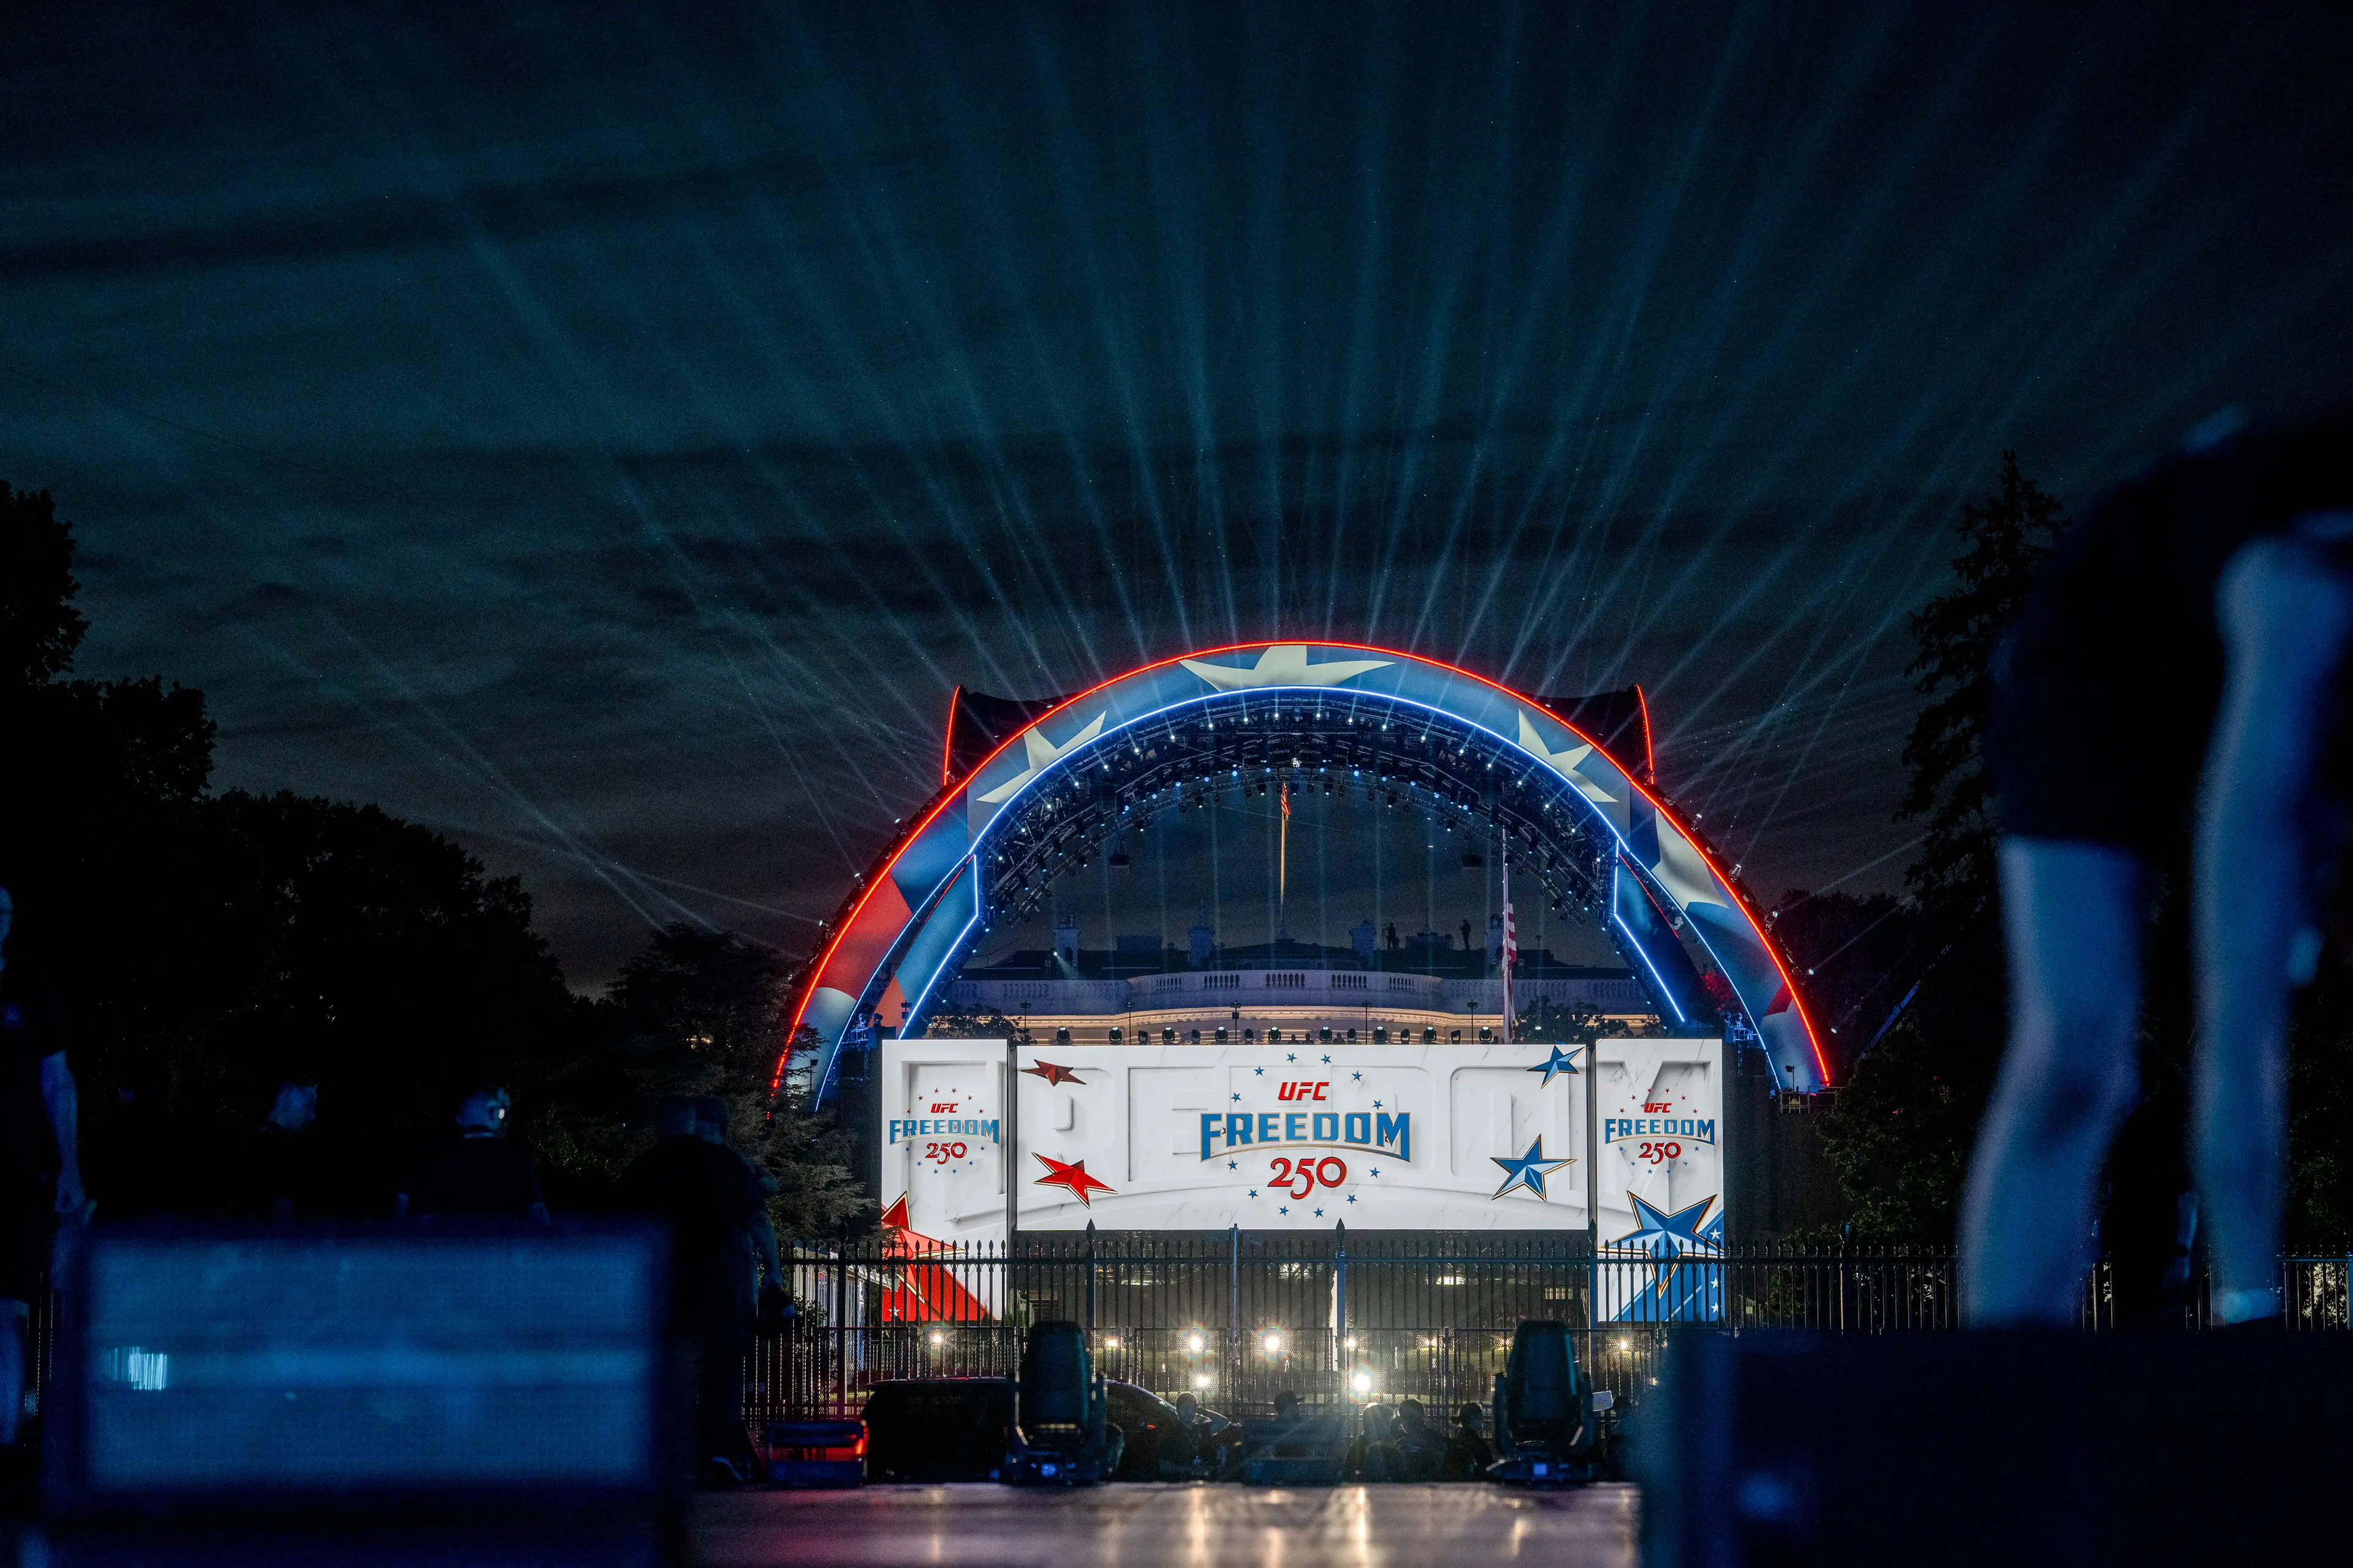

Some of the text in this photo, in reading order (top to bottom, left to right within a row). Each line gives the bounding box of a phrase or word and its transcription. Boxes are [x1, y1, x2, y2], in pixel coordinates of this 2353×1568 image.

[1278, 1081, 1330, 1101] UFC
[930, 1102, 958, 1113] UFC
[1643, 1102, 1672, 1113] UFC
[890, 1118, 1000, 1145] FREEDOM
[1200, 1112, 1411, 1162] FREEDOM
[1604, 1118, 1715, 1145] FREEDOM
[925, 1142, 967, 1165] 250
[1639, 1142, 1682, 1165] 250
[1267, 1157, 1347, 1200] 250
